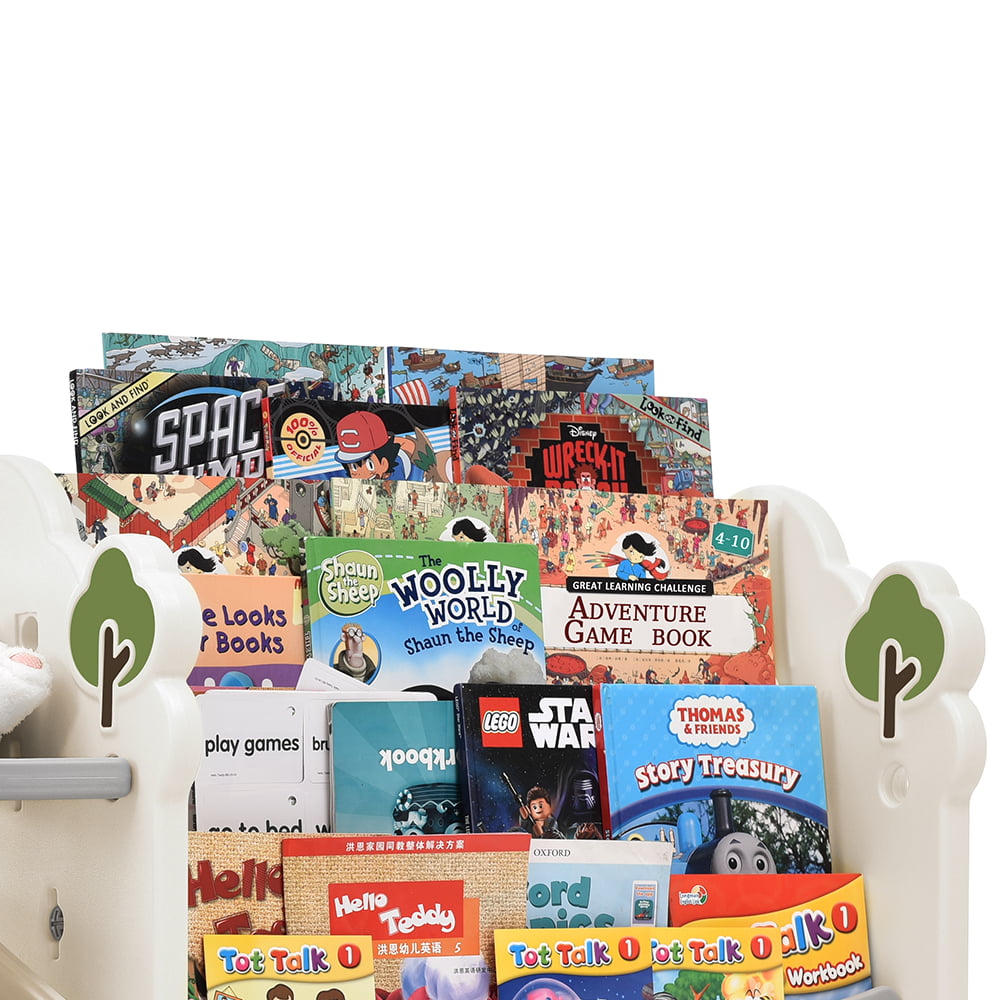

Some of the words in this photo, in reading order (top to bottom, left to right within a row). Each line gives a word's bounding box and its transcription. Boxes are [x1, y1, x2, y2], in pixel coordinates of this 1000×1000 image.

[84, 406, 110, 428] LOOK
[110, 396, 129, 412] AND
[128, 381, 149, 399] FIND
[640, 396, 665, 421] Look
[153, 382, 286, 473] SPAC
[286, 417, 319, 437] 100%
[286, 443, 322, 462] OFFICIAL
[543, 440, 627, 481] WRECK-IT
[320, 556, 378, 582] Shaun
[419, 554, 442, 567] The
[327, 581, 379, 606] Sheep
[343, 576, 359, 587] the
[390, 563, 525, 608] WOOLLY
[572, 580, 603, 591] GREAT
[605, 581, 652, 592] LEARNING
[654, 583, 707, 594] CHALLENGE
[222, 604, 288, 627] Looks
[424, 595, 513, 626] WORLD
[511, 622, 524, 633] of
[215, 631, 285, 654] Books
[403, 631, 453, 656] Shaun
[456, 626, 484, 643] the
[488, 626, 535, 655] Sheep
[483, 712, 519, 732] LEGO
[677, 707, 745, 722] THOMAS
[684, 724, 692, 734] &
[695, 724, 741, 735] FRIENDS
[205, 734, 240, 757] play
[244, 738, 300, 757] games
[634, 757, 694, 790] Story
[697, 754, 801, 791] Treasury
[533, 849, 571, 857] OXFORD
[334, 892, 388, 917] Hello
[527, 875, 592, 909] ord
[379, 903, 456, 936] Teddy
[754, 910, 833, 955] alk
[219, 947, 265, 972] Tot
[270, 946, 329, 972] Talk
[377, 942, 442, 956] 洪恩幼儿英语
[454, 942, 462, 953] 5
[509, 943, 551, 966] Tot
[556, 940, 611, 965] Talk
[688, 938, 743, 962] Talk
[786, 952, 865, 987] Workbook
